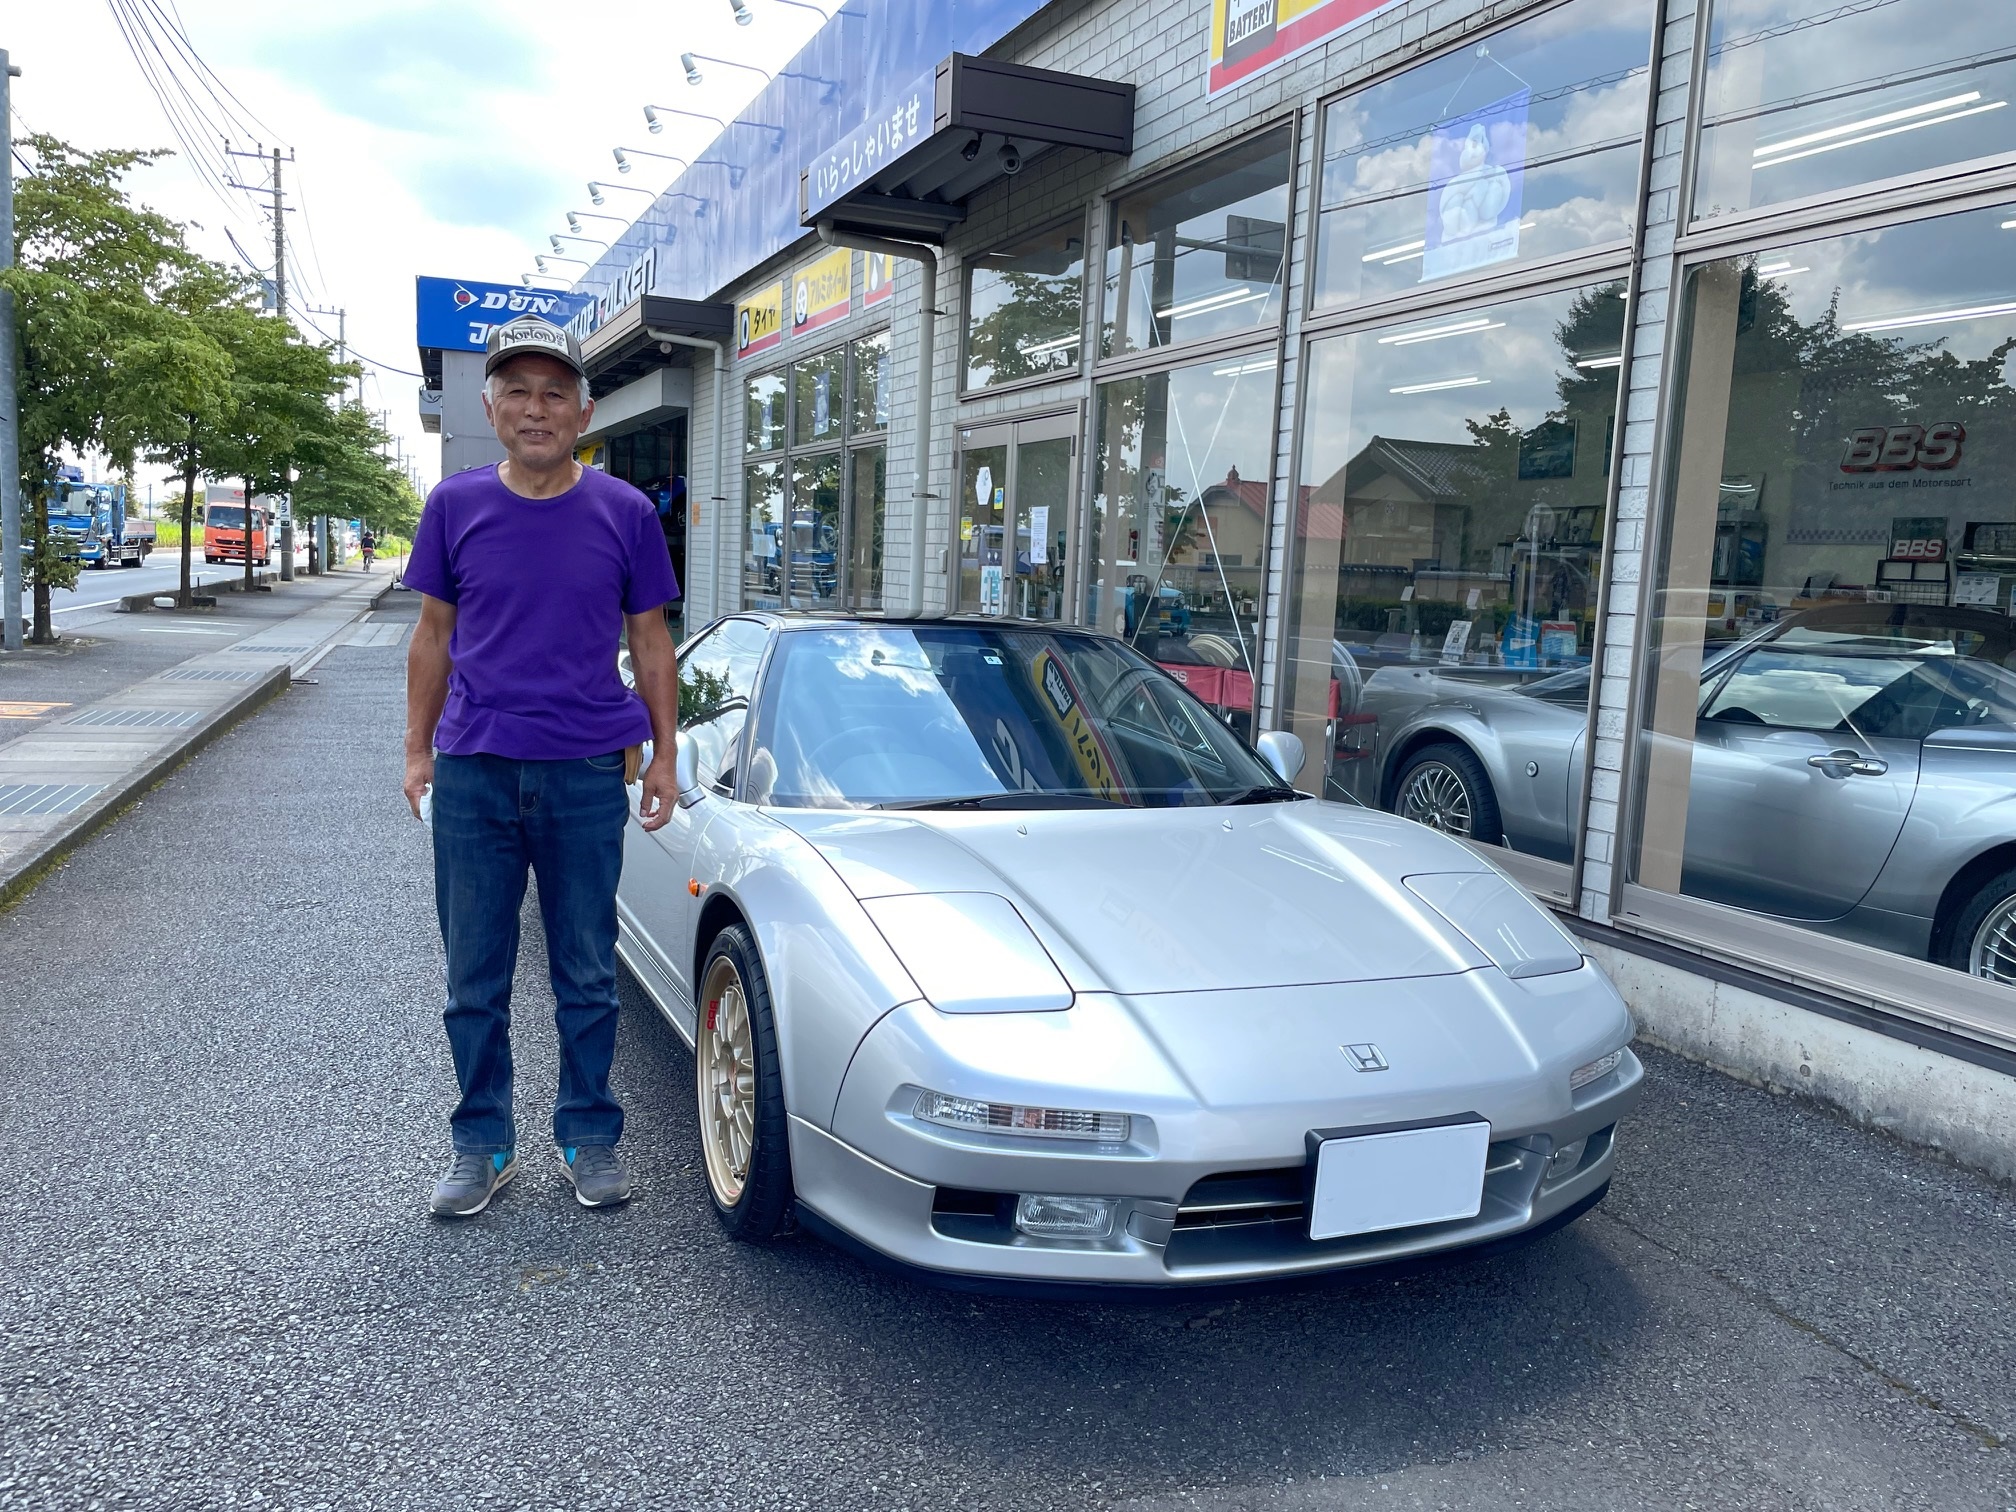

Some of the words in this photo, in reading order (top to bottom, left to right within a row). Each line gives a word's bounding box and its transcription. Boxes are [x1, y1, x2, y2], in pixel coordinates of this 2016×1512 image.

[1229, 0, 1272, 44] BATTERY
[817, 93, 920, 199] いらっしゃいませ
[597, 246, 656, 328] FALKEN
[810, 263, 848, 309] アルミホイール
[501, 326, 556, 347] Norton
[753, 306, 776, 335] タイヤ
[1840, 421, 1966, 473] BBS
[1828, 480, 1864, 491] Technik
[1868, 481, 1884, 489] aus
[1889, 479, 1909, 489] dem
[1912, 477, 1972, 488] Motorsport
[1892, 539, 1943, 557] BBS
